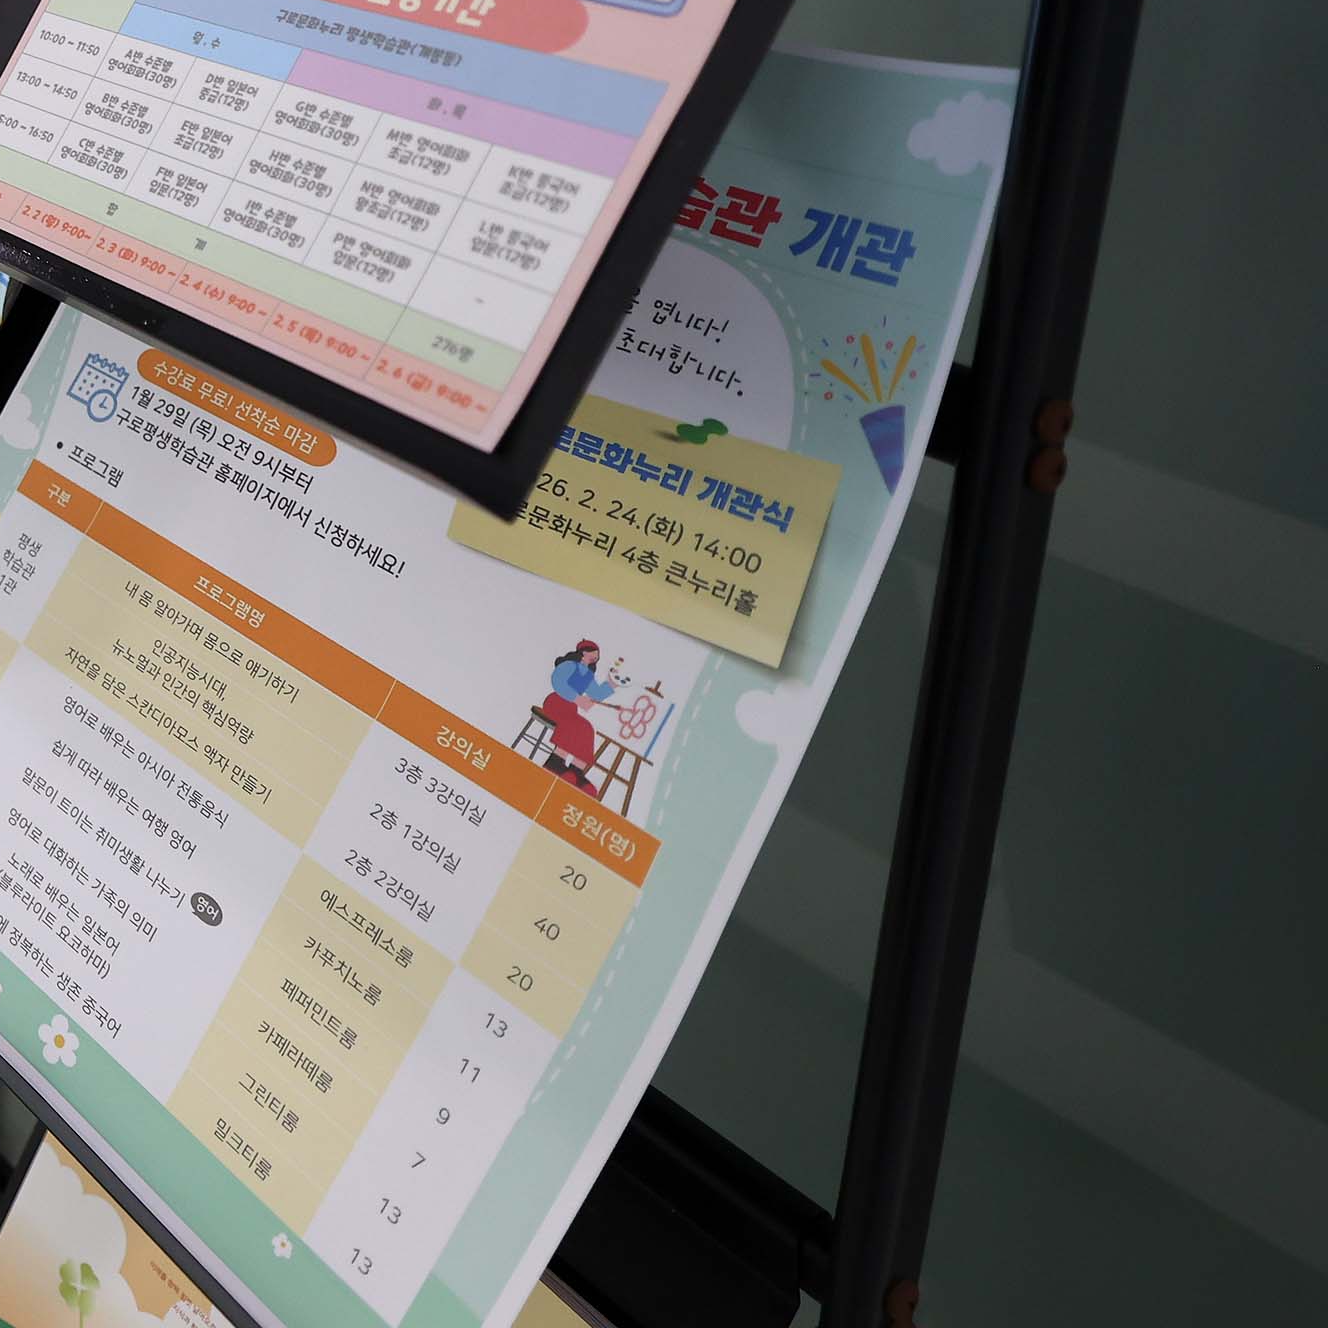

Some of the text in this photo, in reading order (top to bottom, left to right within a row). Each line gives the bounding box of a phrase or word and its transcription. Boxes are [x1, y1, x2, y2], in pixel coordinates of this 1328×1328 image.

[39, 29, 101, 57] 10:00 11:50
[123, 49, 144, 63] A반
[16, 70, 79, 101] 13:00 14:50
[27, 124, 55, 143] 16:50
[789, 208, 918, 287] 개관
[652, 298, 730, 343] 엽니다!
[616, 326, 744, 397] 초대합니다.
[153, 360, 319, 456] 수강료 무료! 선착순 마감
[67, 445, 125, 488] 프로그램
[131, 385, 315, 495] 1월 29일 (목) 오전 9시부터
[47, 483, 72, 508] 구분
[116, 408, 406, 580] 구로평생학습관 홈페이지에서 신청하세요!
[696, 476, 796, 533] 개관식
[17, 533, 43, 558] 평생
[578, 488, 597, 512] 2.
[610, 499, 685, 546] 24.(화)
[693, 531, 763, 574] 14:00
[2, 549, 37, 581] 학습관
[620, 548, 660, 575] 4층
[664, 560, 760, 616] 큰누리홀
[193, 575, 266, 629] 프로그램명
[124, 580, 301, 704] 내 몸 알아가며 몸으로 얘기하기
[151, 639, 229, 703] 인공지능시대,
[112, 638, 255, 745] 뉴노멀과 인간의 핵심역량
[62, 695, 230, 830] 영어로 배우는 아시아 전통음식
[433, 724, 492, 771] 강의실
[394, 757, 489, 828] 3층 3강의실
[368, 803, 463, 876] 2층 1강의실
[561, 803, 637, 863] 정원(명)
[344, 849, 437, 925] 2층 2강의실
[559, 865, 588, 892] 20
[319, 888, 416, 971] 에스프레소룸
[534, 917, 561, 942] 40
[303, 935, 384, 1008] 카푸치노룸
[506, 965, 535, 993] 20
[279, 977, 360, 1053] 페퍼민트룸
[484, 1012, 509, 1039] 13
[257, 1020, 336, 1095] 카페라떼룸
[459, 1058, 482, 1085] 11
[237, 1071, 301, 1136] 그린티룸
[435, 1107, 452, 1127] 9
[212, 1117, 274, 1183] 밀크티룸
[410, 1152, 427, 1170] 7
[380, 1197, 403, 1226] 13
[350, 1248, 374, 1278] 13
